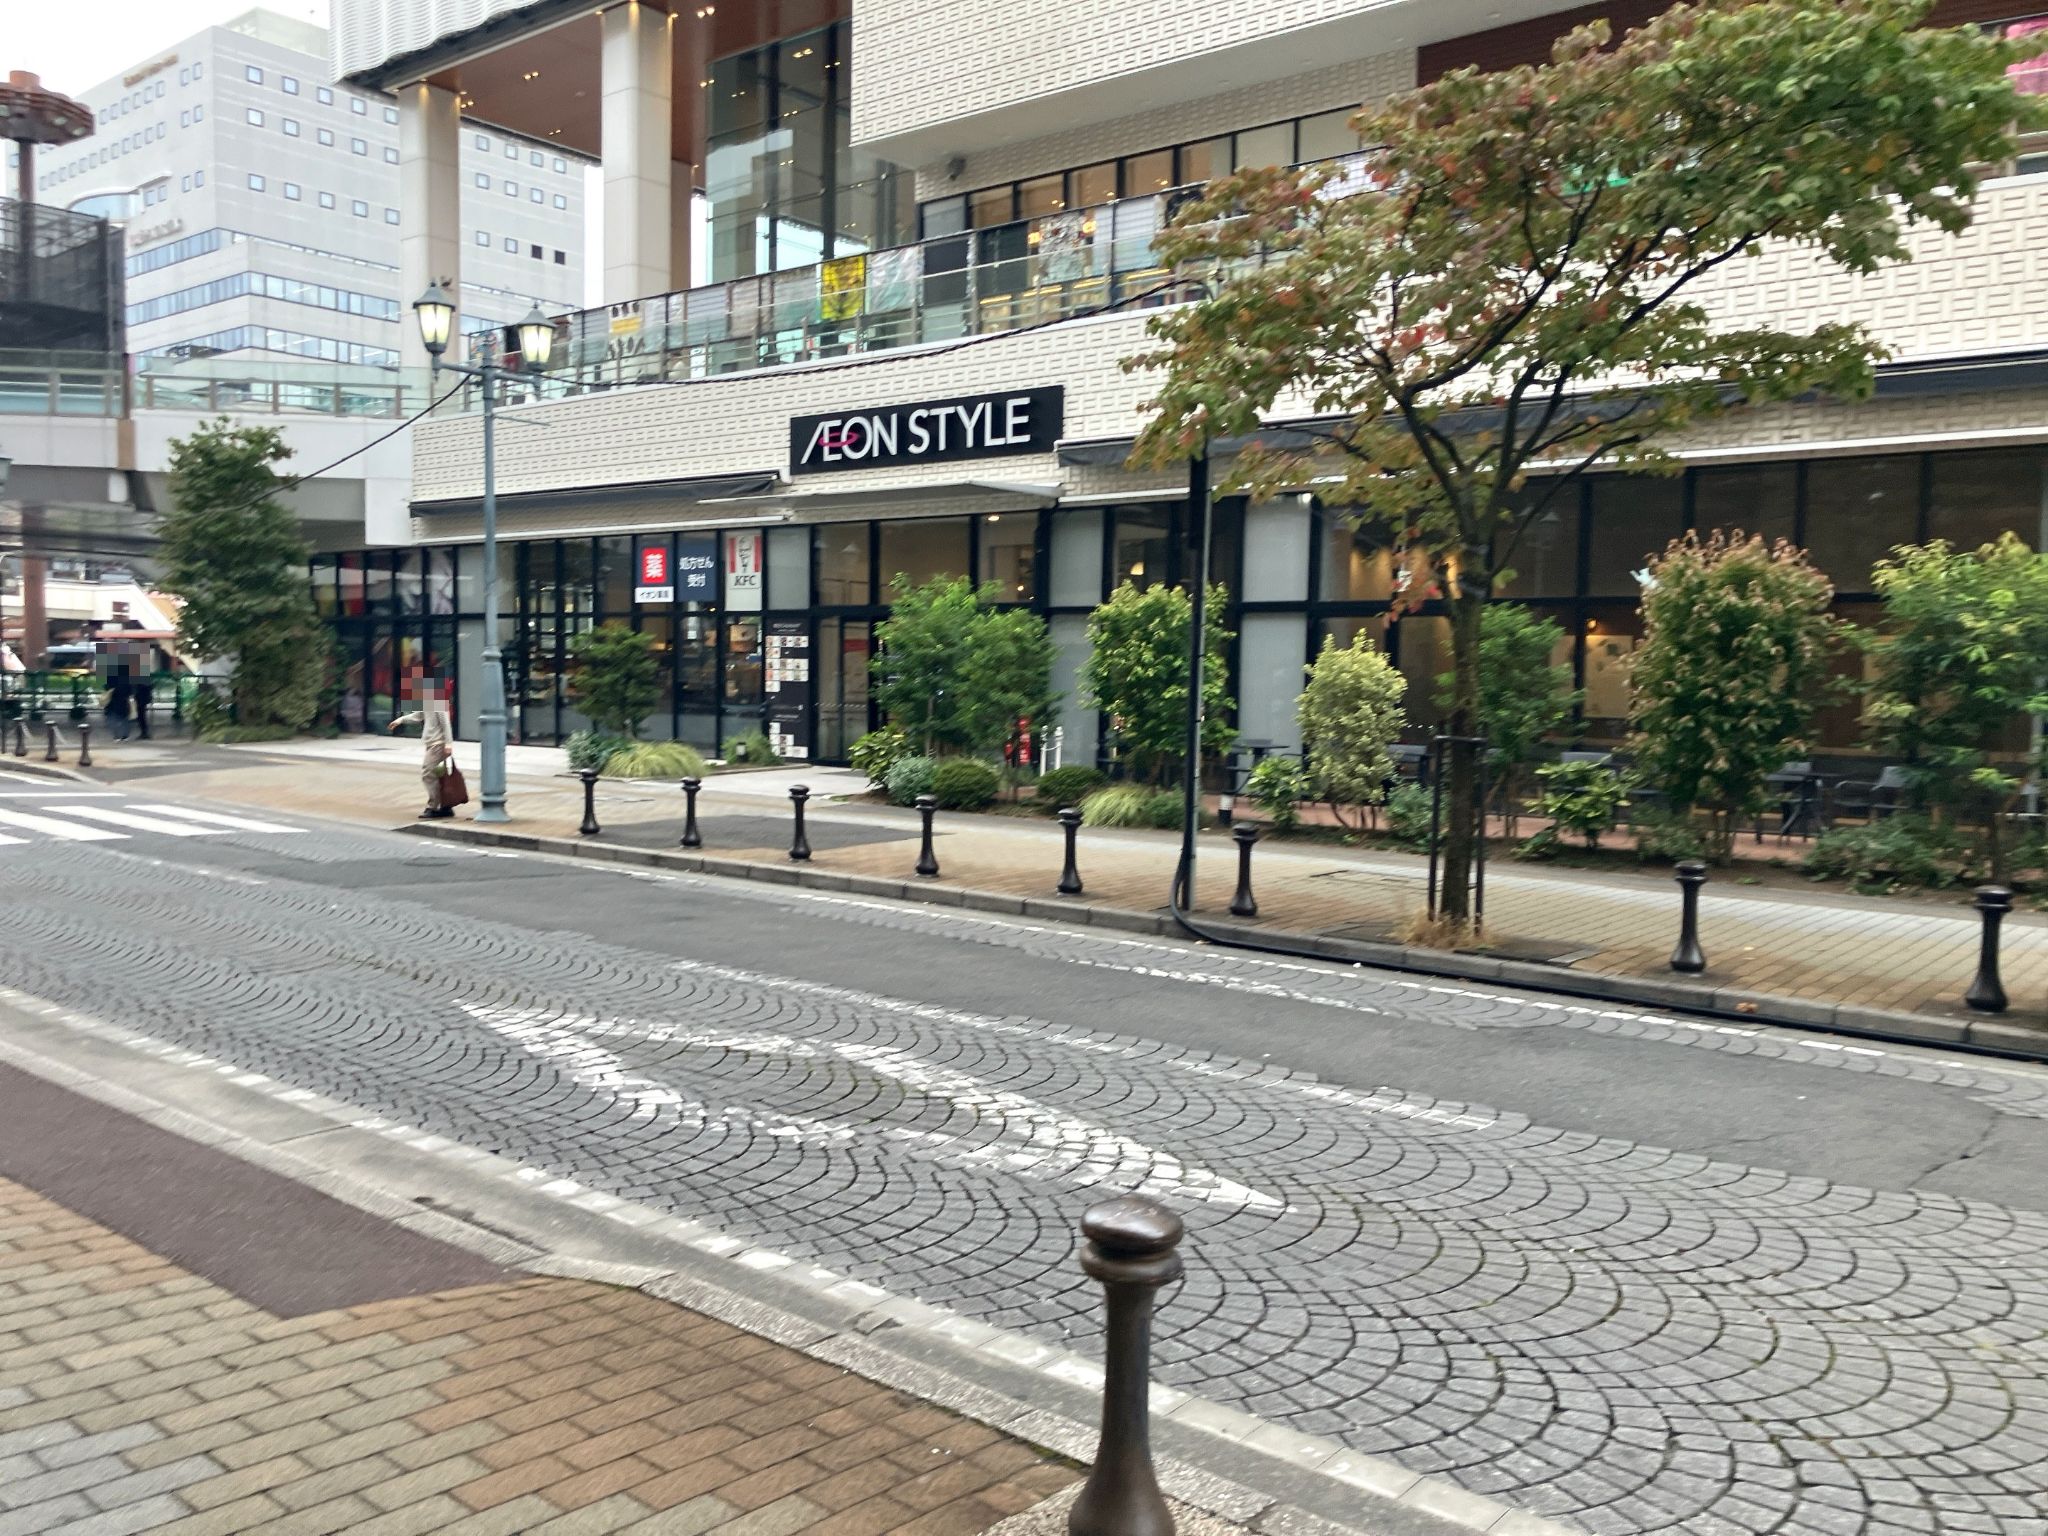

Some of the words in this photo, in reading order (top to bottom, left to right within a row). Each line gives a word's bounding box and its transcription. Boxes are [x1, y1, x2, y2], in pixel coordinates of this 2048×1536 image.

[907, 396, 1031, 455] STYLE
[645, 553, 663, 578] 薬
[679, 555, 715, 570] 処方せん
[687, 572, 706, 588] 受付
[734, 575, 757, 587] KFC
